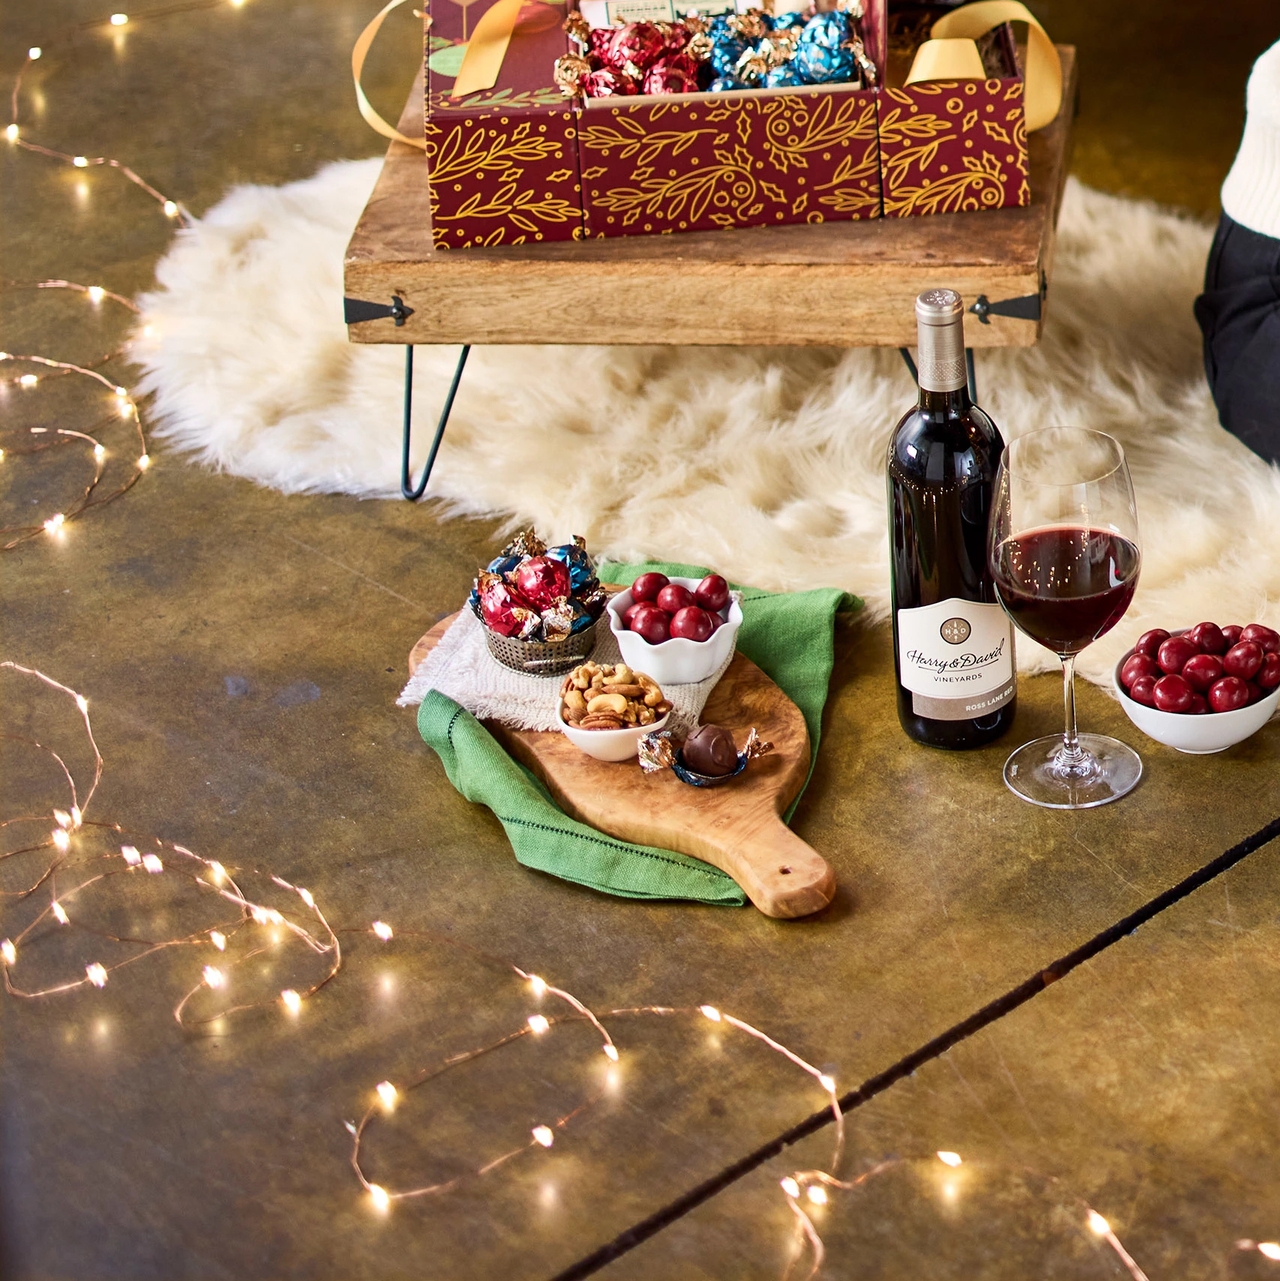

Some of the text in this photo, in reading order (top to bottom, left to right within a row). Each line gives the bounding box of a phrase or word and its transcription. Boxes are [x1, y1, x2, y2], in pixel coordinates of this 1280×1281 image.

[906, 649, 949, 674] Harry
[960, 637, 1005, 669] David
[933, 672, 983, 683] VINEYARDS
[965, 685, 1014, 712] ROSS LANE RED
